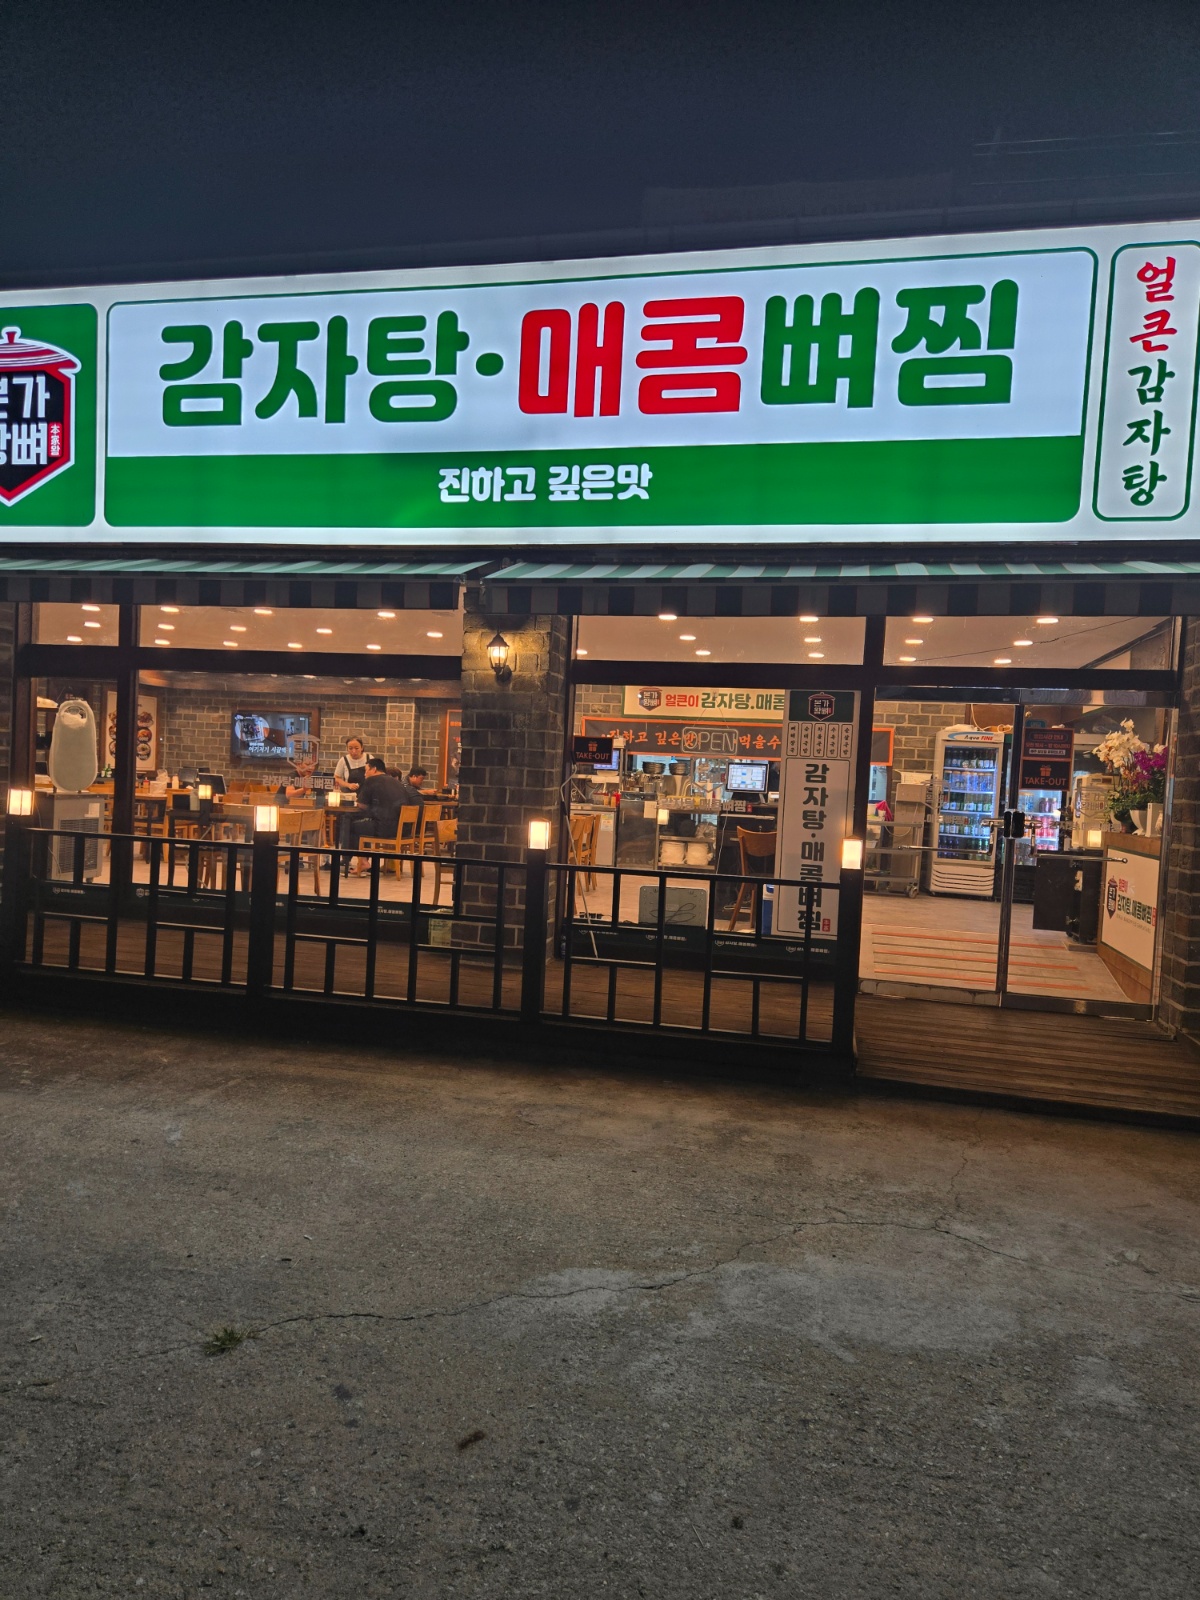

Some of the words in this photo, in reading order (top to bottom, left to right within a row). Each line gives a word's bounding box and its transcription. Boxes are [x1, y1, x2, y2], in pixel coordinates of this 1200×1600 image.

[438, 466, 537, 503] 진하고
[547, 463, 653, 501] 깊은맛
[665, 694, 699, 708] 얼큰이
[685, 731, 736, 752] OPEN
[575, 751, 610, 760] TAKE-OUT
[1024, 777, 1067, 786] TAKE-OUT
